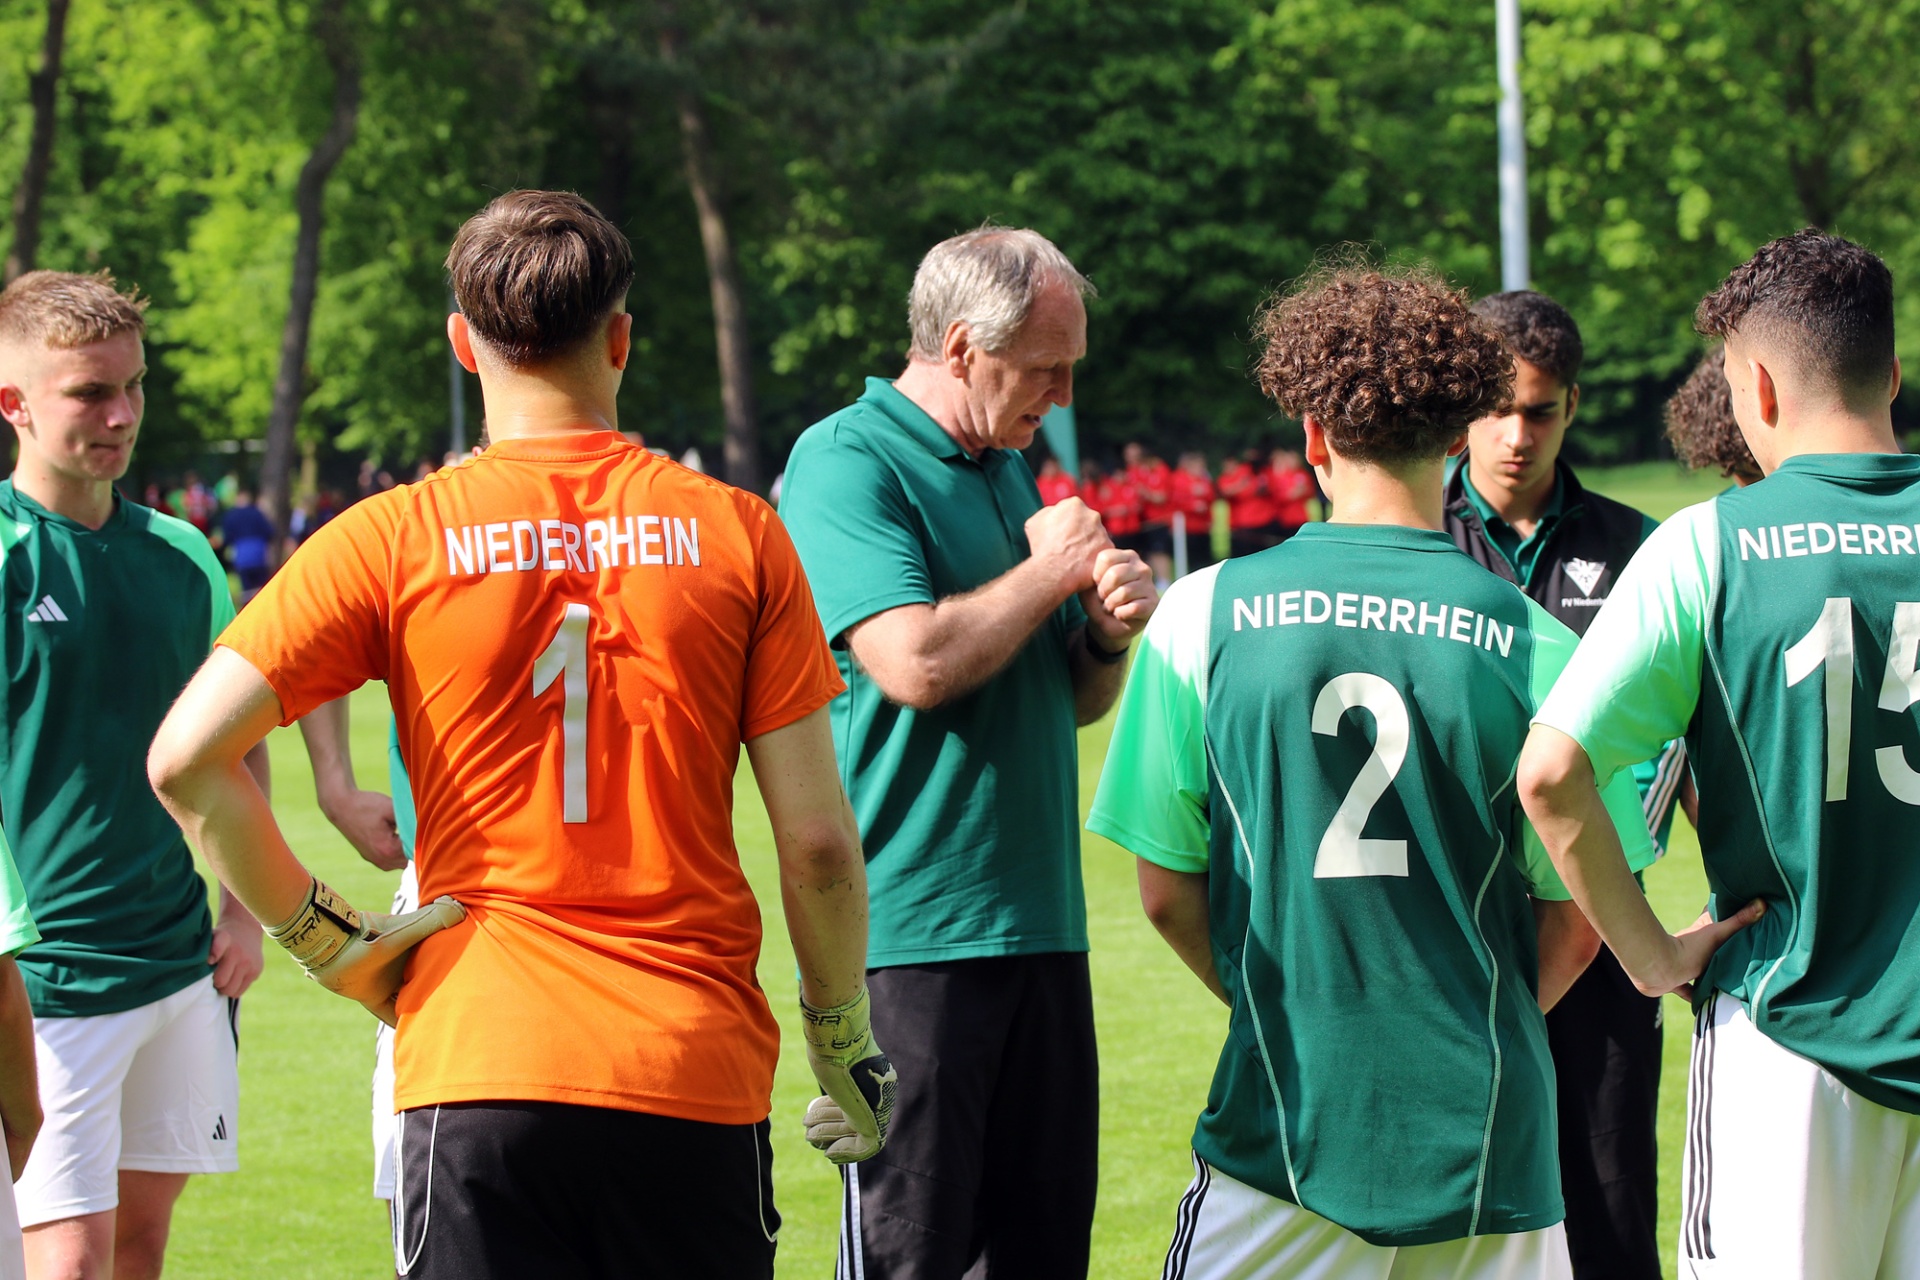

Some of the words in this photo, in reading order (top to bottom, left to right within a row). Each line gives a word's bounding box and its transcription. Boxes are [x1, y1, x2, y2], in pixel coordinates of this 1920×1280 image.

[445, 515, 701, 576] NIEDERRHEIN
[1738, 522, 1920, 561] NIEDERR
[1232, 590, 1514, 659] NIEDERRHEIN
[533, 603, 589, 823] 1
[1311, 672, 1410, 878] 2
